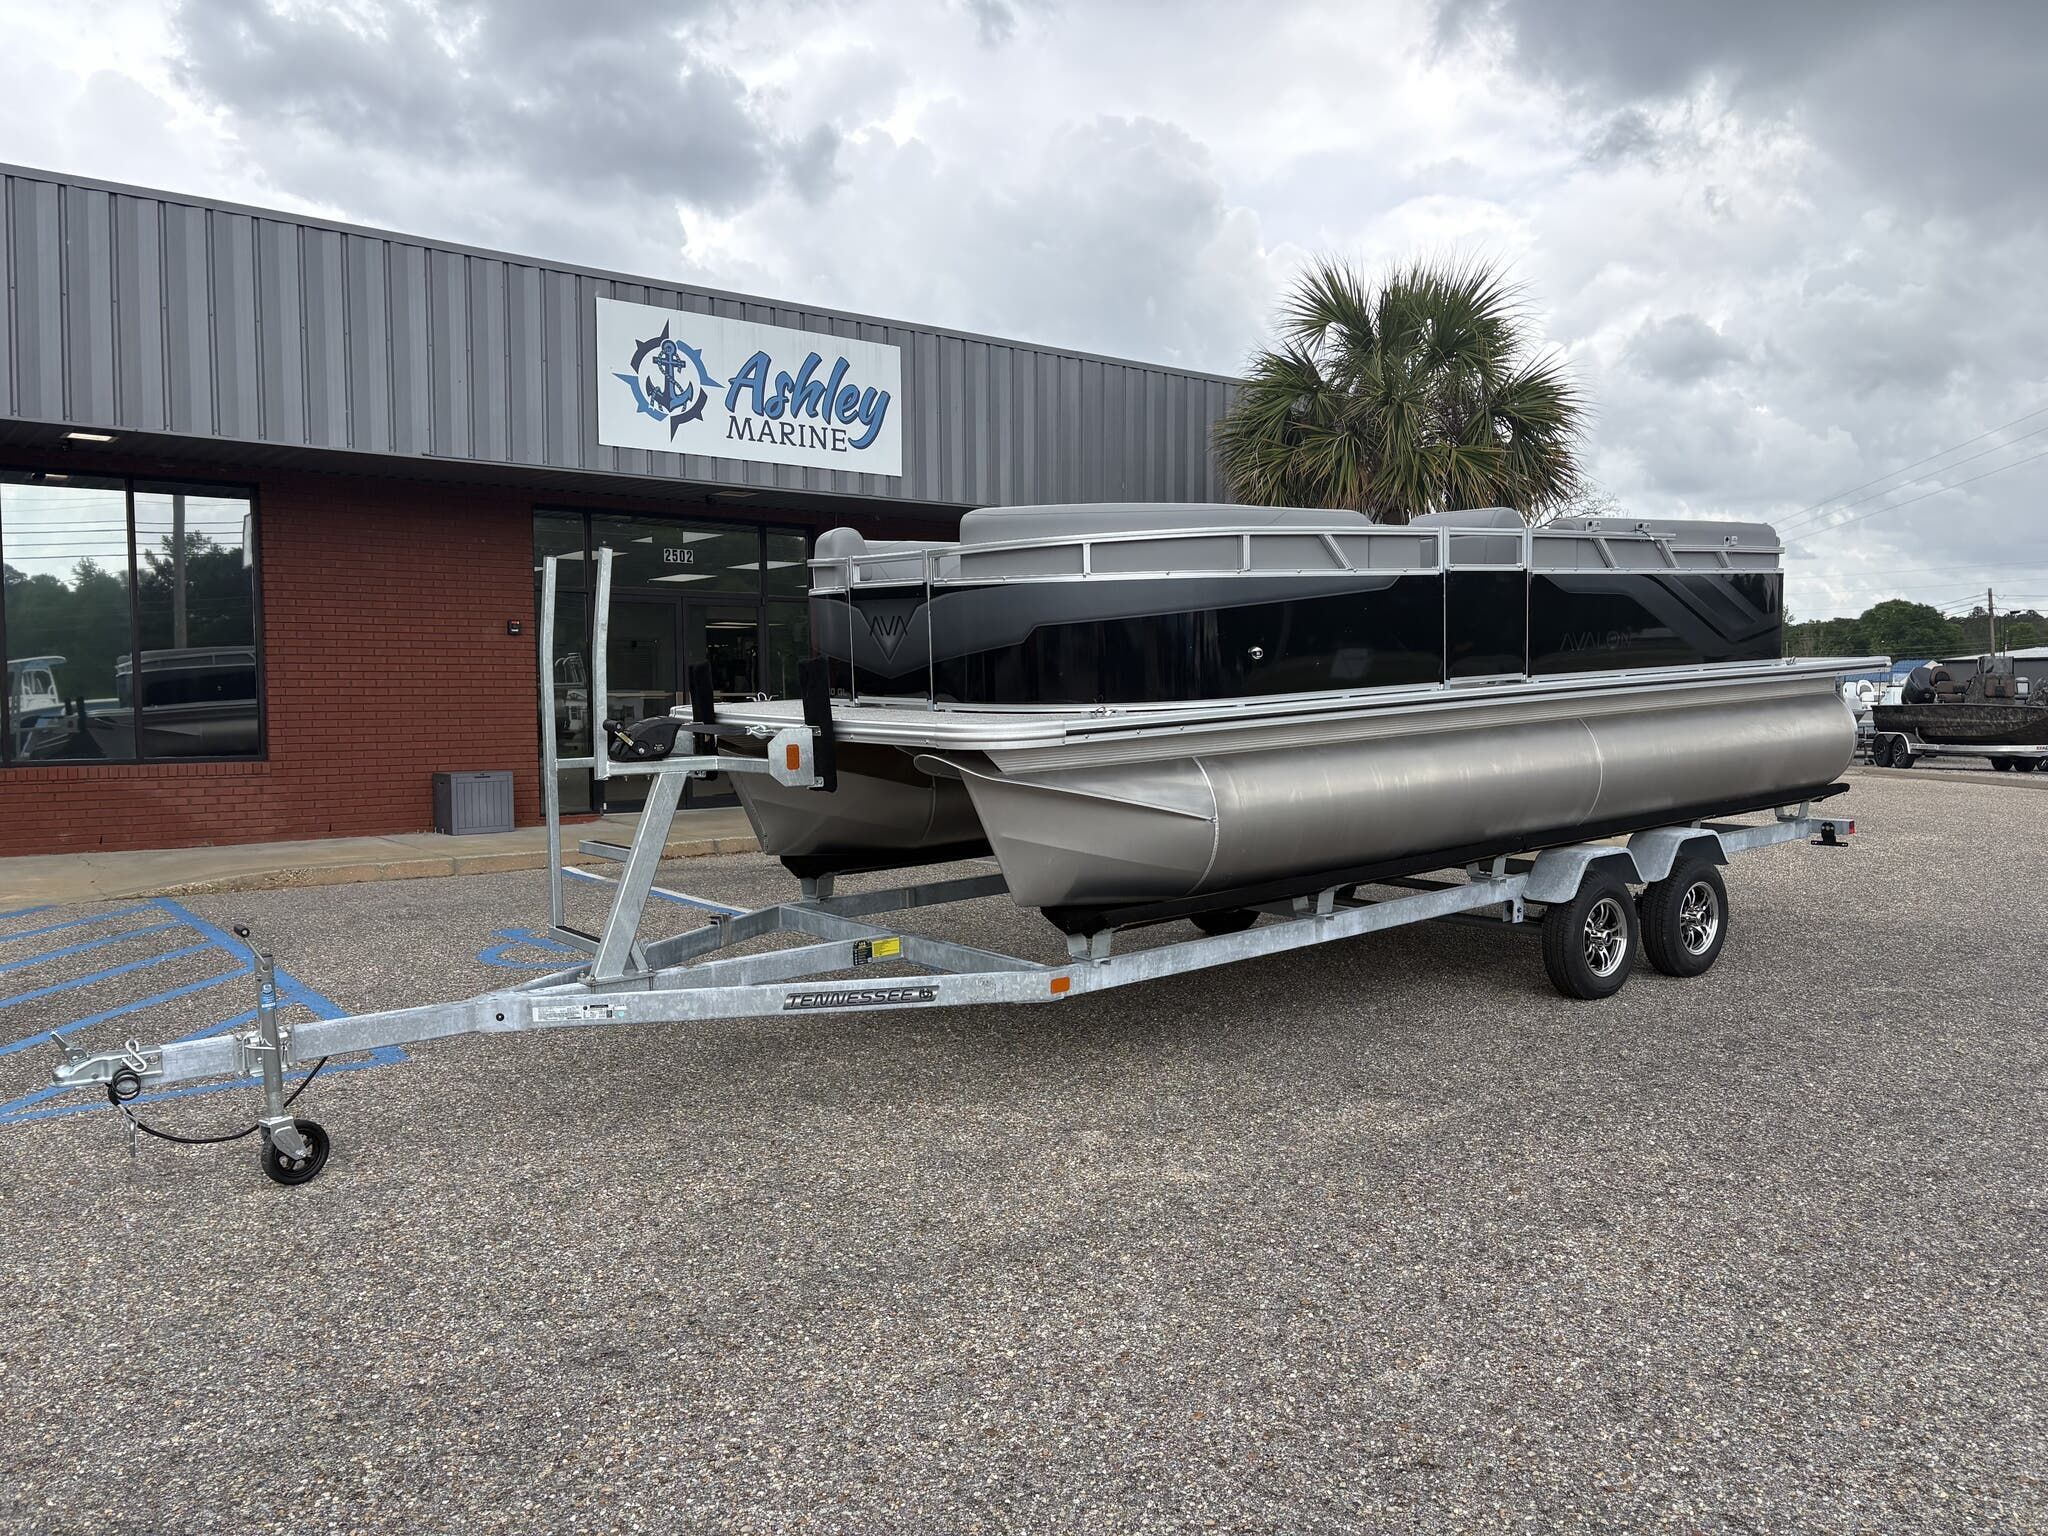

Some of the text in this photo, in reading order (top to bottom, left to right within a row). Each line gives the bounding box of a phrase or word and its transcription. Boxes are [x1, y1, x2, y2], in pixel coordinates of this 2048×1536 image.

[725, 350, 891, 450] Ashley
[726, 415, 848, 453] MARINE
[665, 549, 693, 563] 2502
[788, 988, 914, 1008] TENNESSEE
